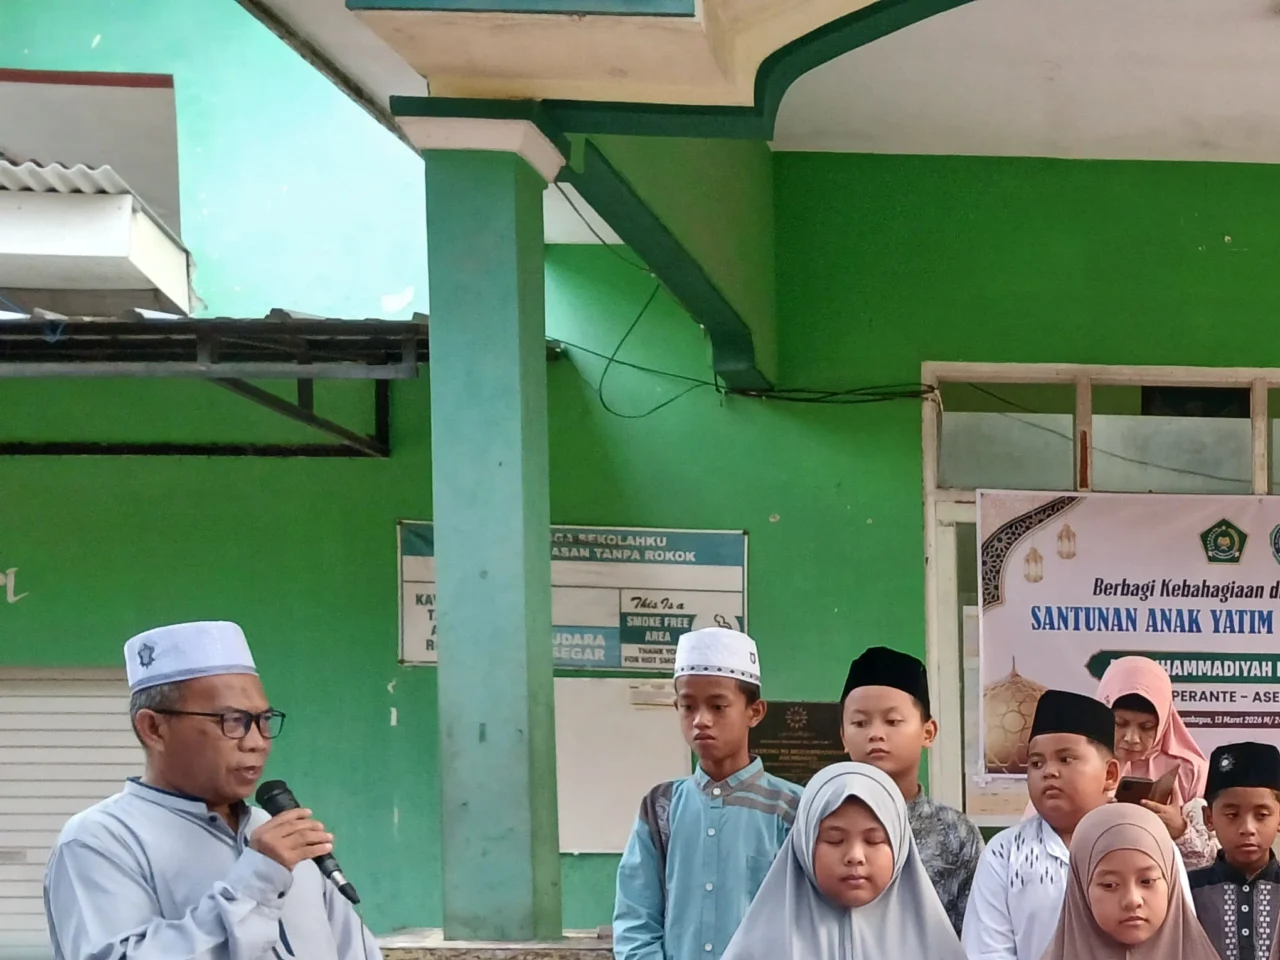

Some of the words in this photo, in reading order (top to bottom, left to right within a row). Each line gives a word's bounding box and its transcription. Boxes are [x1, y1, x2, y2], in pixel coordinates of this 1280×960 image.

[578, 534, 667, 547] SEKOLAHKU
[552, 547, 590, 558] ASAN
[594, 548, 640, 560] TANPA
[644, 550, 696, 562] ROKOK
[1092, 577, 1156, 602] Berbagi
[1160, 578, 1264, 603] Kebahagiaan
[630, 597, 658, 609] This
[660, 598, 673, 609] Is
[676, 601, 685, 610] a
[626, 616, 662, 627] SMOKE
[664, 617, 690, 628] FREE
[1031, 606, 1138, 633] SANTUNAN
[1145, 608, 1203, 634] ANAK
[1210, 609, 1273, 634] YATIM
[645, 631, 671, 642] AREA
[1158, 659, 1272, 677] HAMMADIYAH
[1172, 690, 1237, 702] PERANTE
[1182, 716, 1213, 725] embagus,
[1223, 716, 1243, 724] Maret
[1244, 716, 1262, 724] 2026
